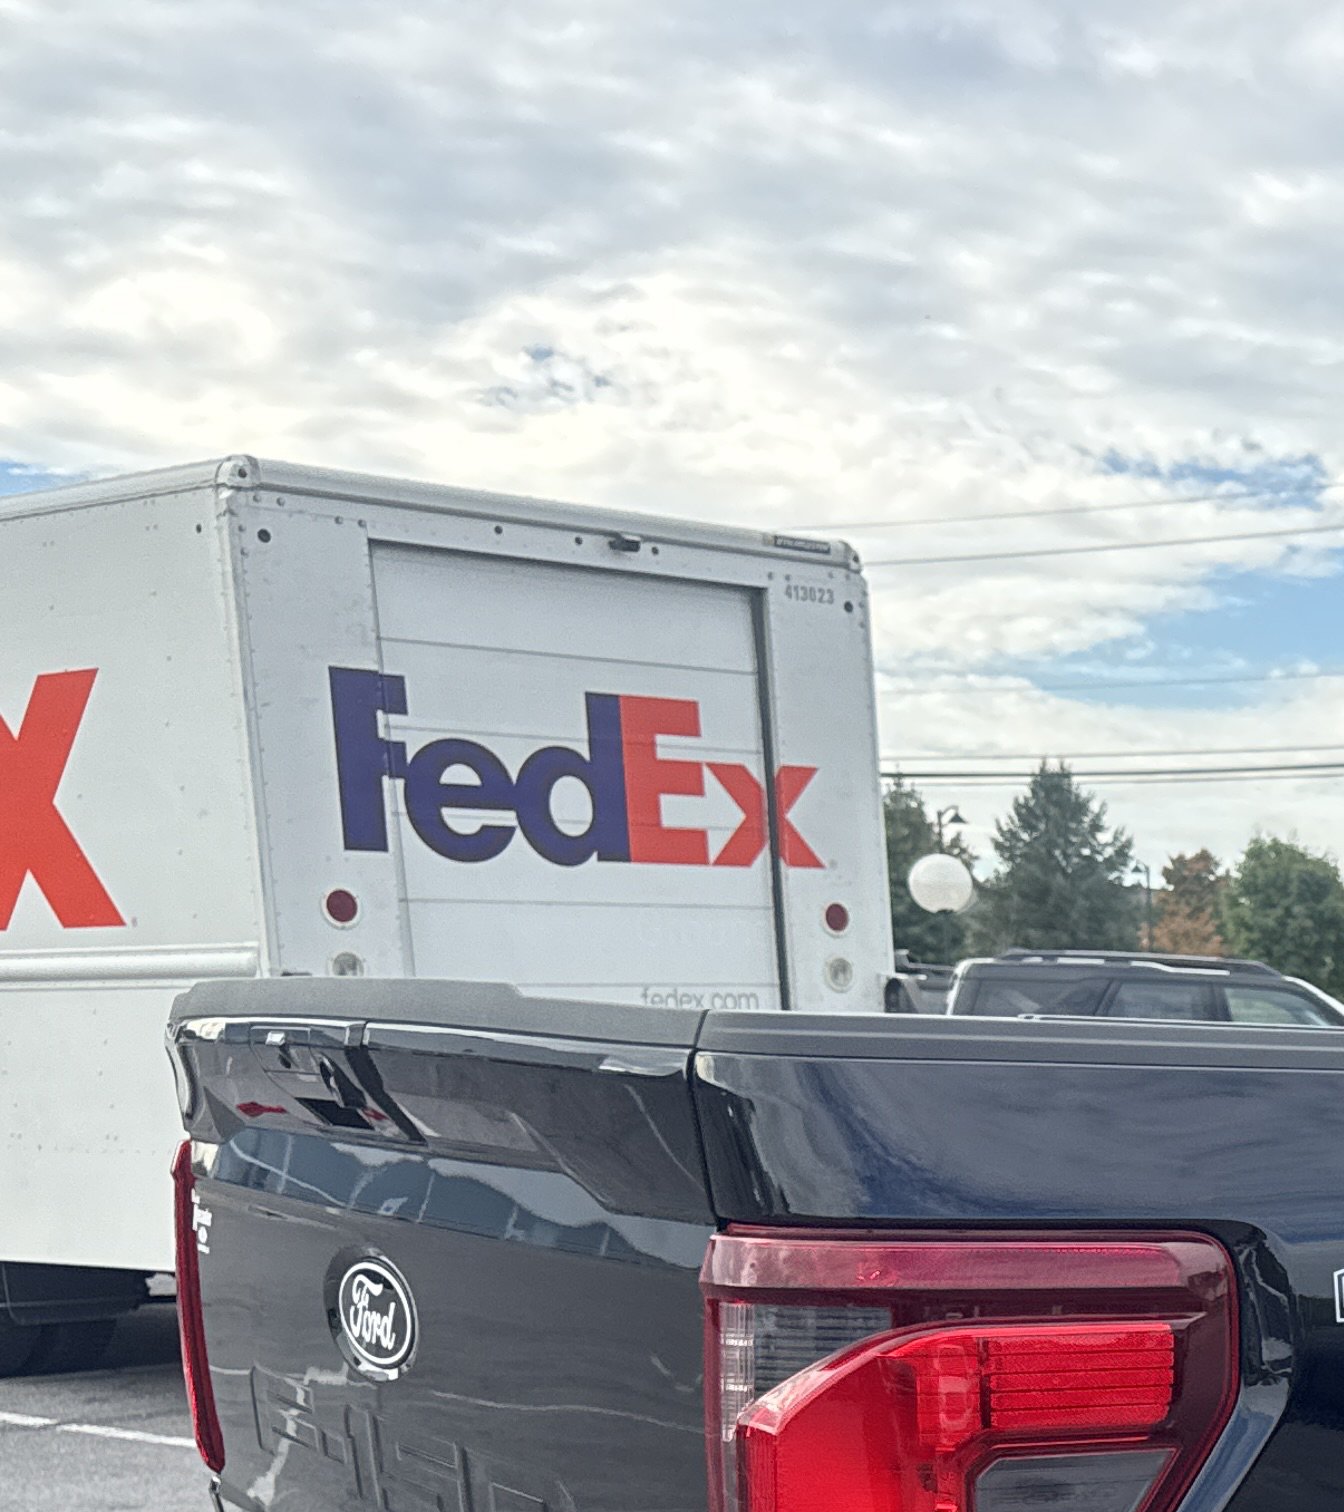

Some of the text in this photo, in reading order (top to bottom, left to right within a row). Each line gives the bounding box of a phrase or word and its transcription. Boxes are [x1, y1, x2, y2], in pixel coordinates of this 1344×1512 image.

[785, 584, 834, 605] 413023
[328, 665, 825, 868] FedEx
[640, 986, 759, 1010] fedexcom
[350, 1274, 396, 1350] Ford
